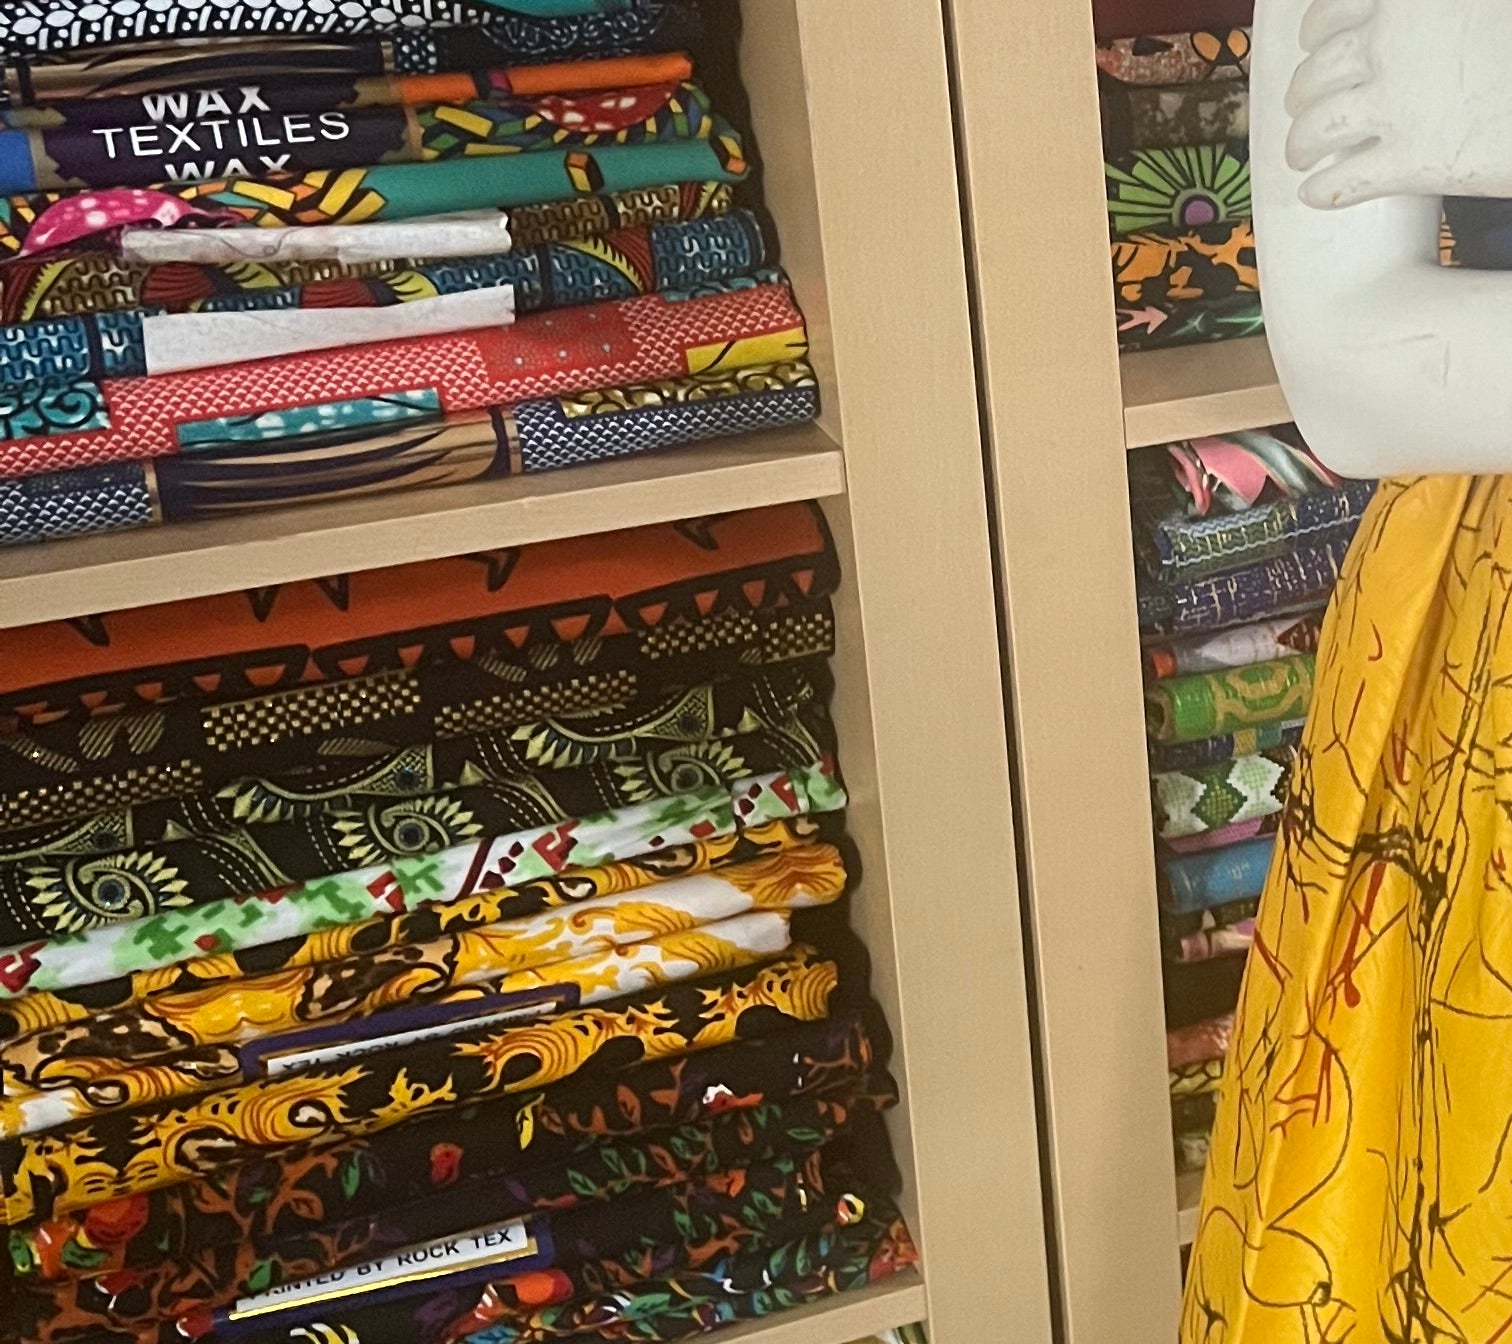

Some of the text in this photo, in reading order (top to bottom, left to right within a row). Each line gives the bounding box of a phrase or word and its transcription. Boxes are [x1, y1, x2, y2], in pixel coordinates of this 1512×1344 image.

[142, 86, 271, 121] WAX
[92, 112, 350, 159] TEXTILES
[398, 1238, 460, 1267] ROCK
[471, 1229, 513, 1250] TEX
